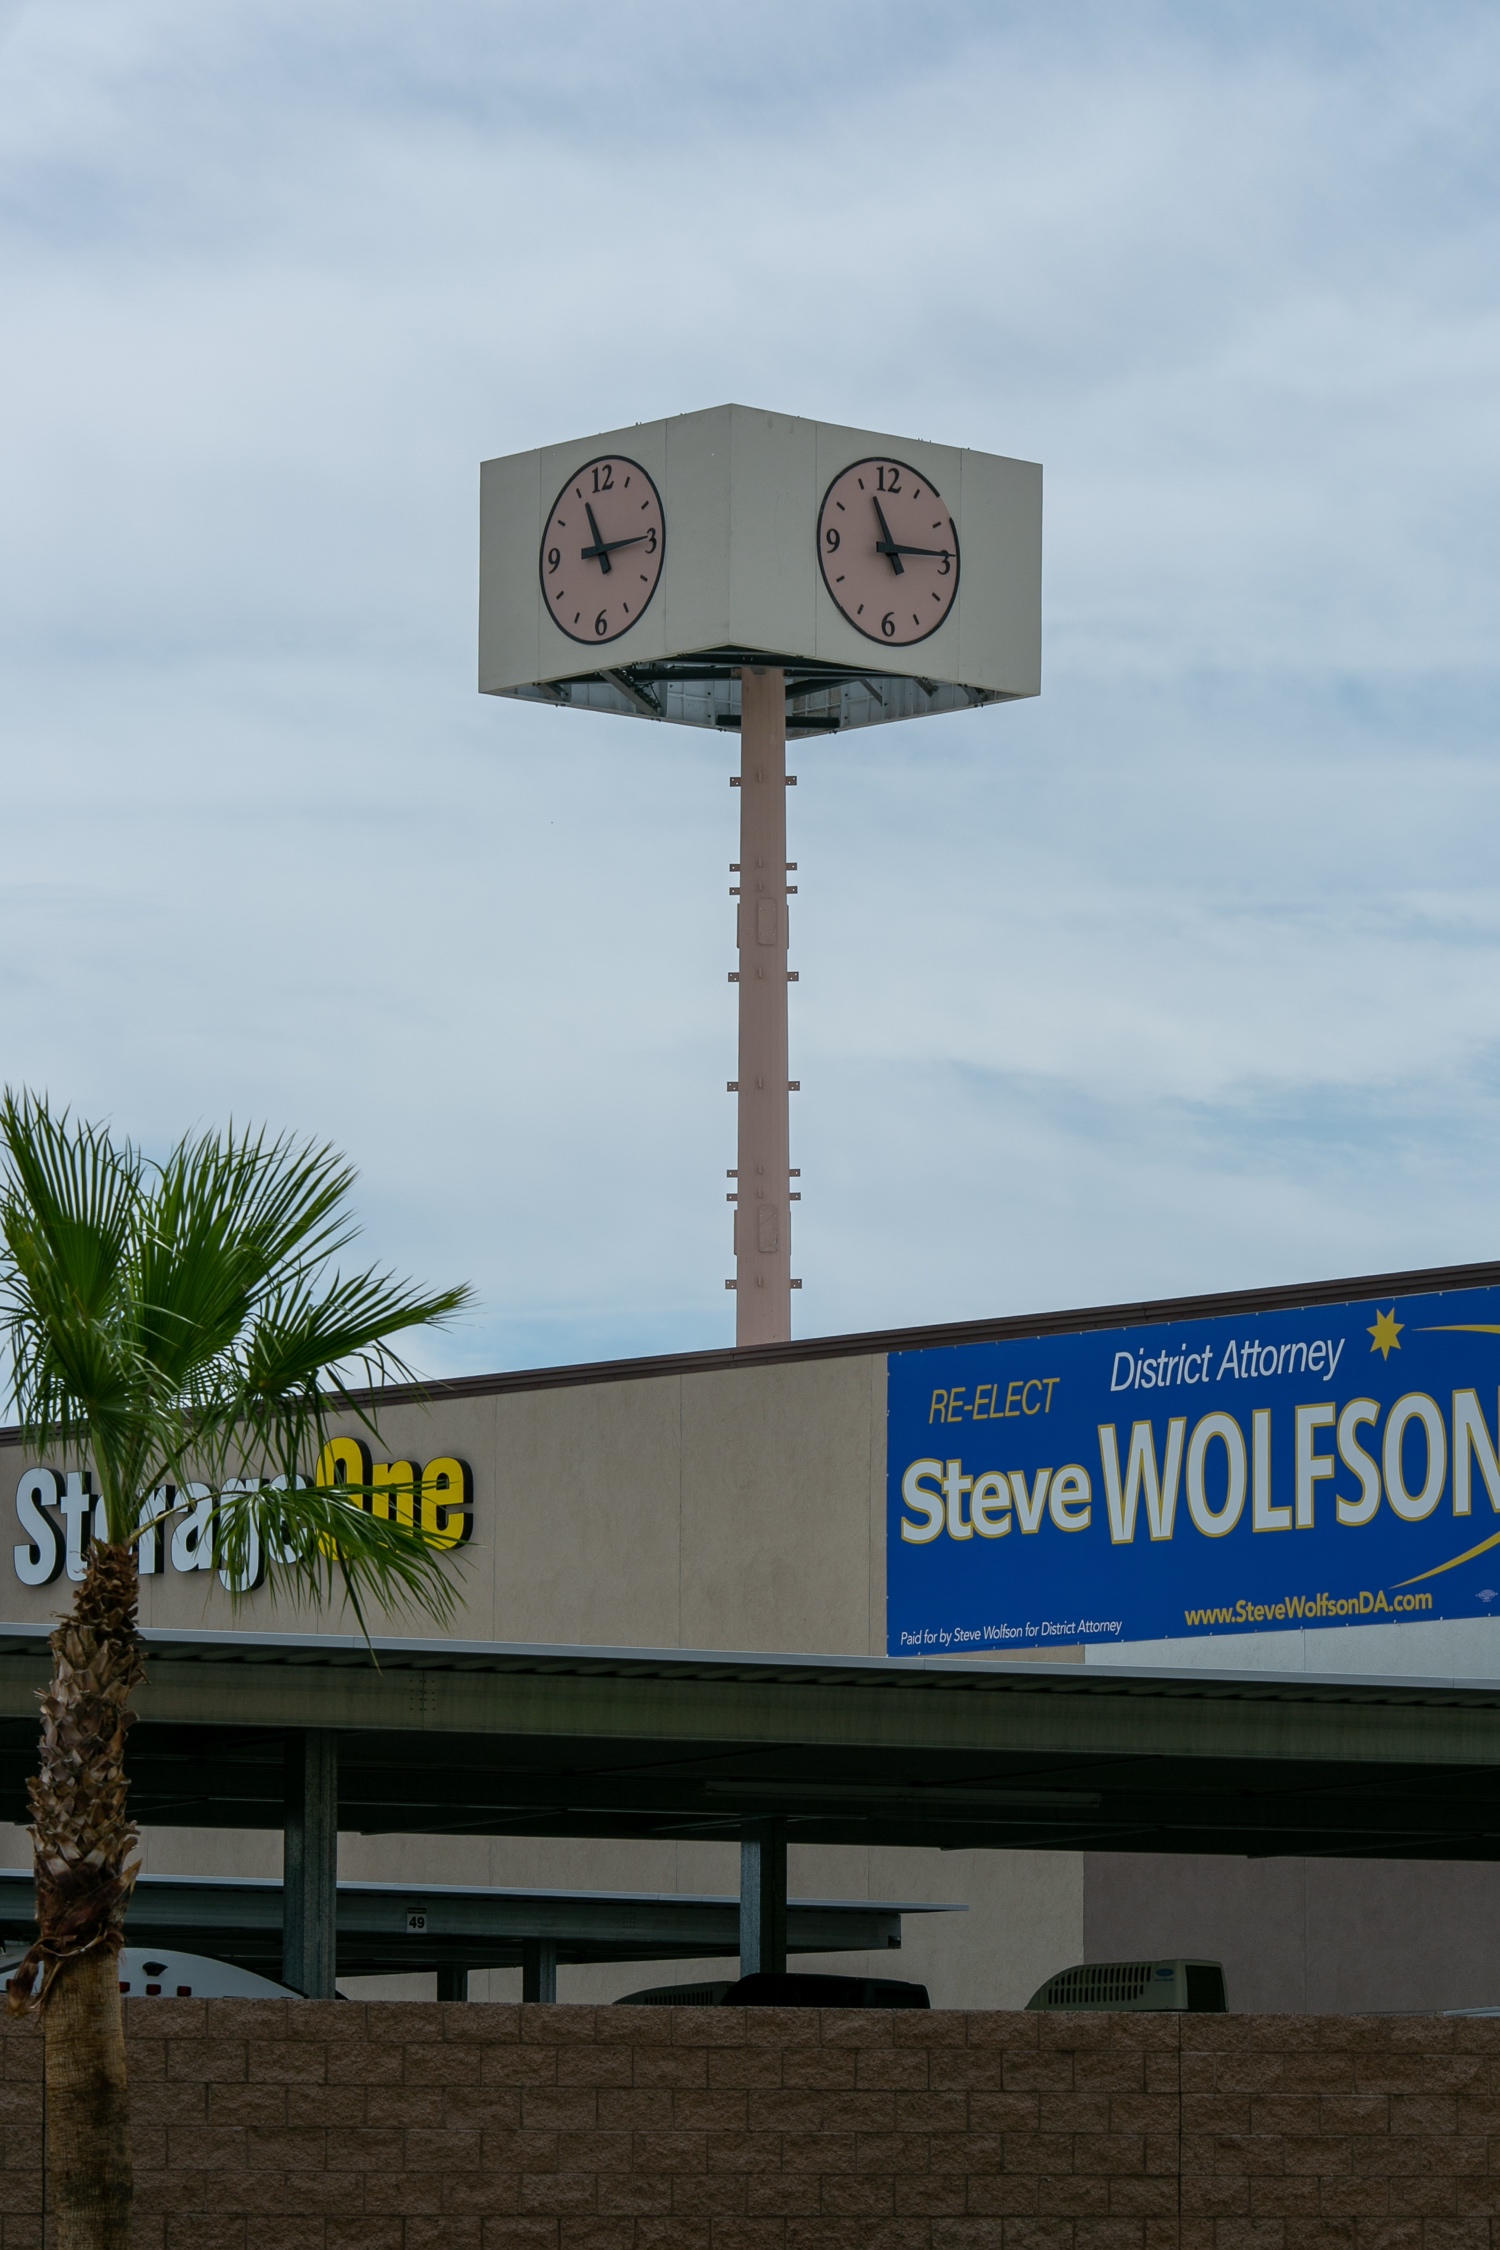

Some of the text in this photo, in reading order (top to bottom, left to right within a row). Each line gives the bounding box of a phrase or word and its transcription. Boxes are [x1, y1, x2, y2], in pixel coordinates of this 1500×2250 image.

[591, 464, 615, 494] 12
[875, 466, 902, 494] 12
[645, 527, 658, 553] 3
[826, 528, 840, 553] 9
[547, 548, 561, 574] 9
[936, 550, 951, 574] 3
[594, 608, 608, 636] 6
[880, 612, 896, 637] 6
[1110, 1338, 1345, 1391] District Attorney
[928, 1377, 1060, 1424] RE-ELECT
[901, 1387, 1500, 1545] Steve WOLFSON
[1184, 1590, 1433, 1626] www.SteveWolfsonDA.com
[900, 1618, 1123, 1646] Paid for by Steve Wolfson for District Attorney
[409, 1916, 425, 1929] 49
